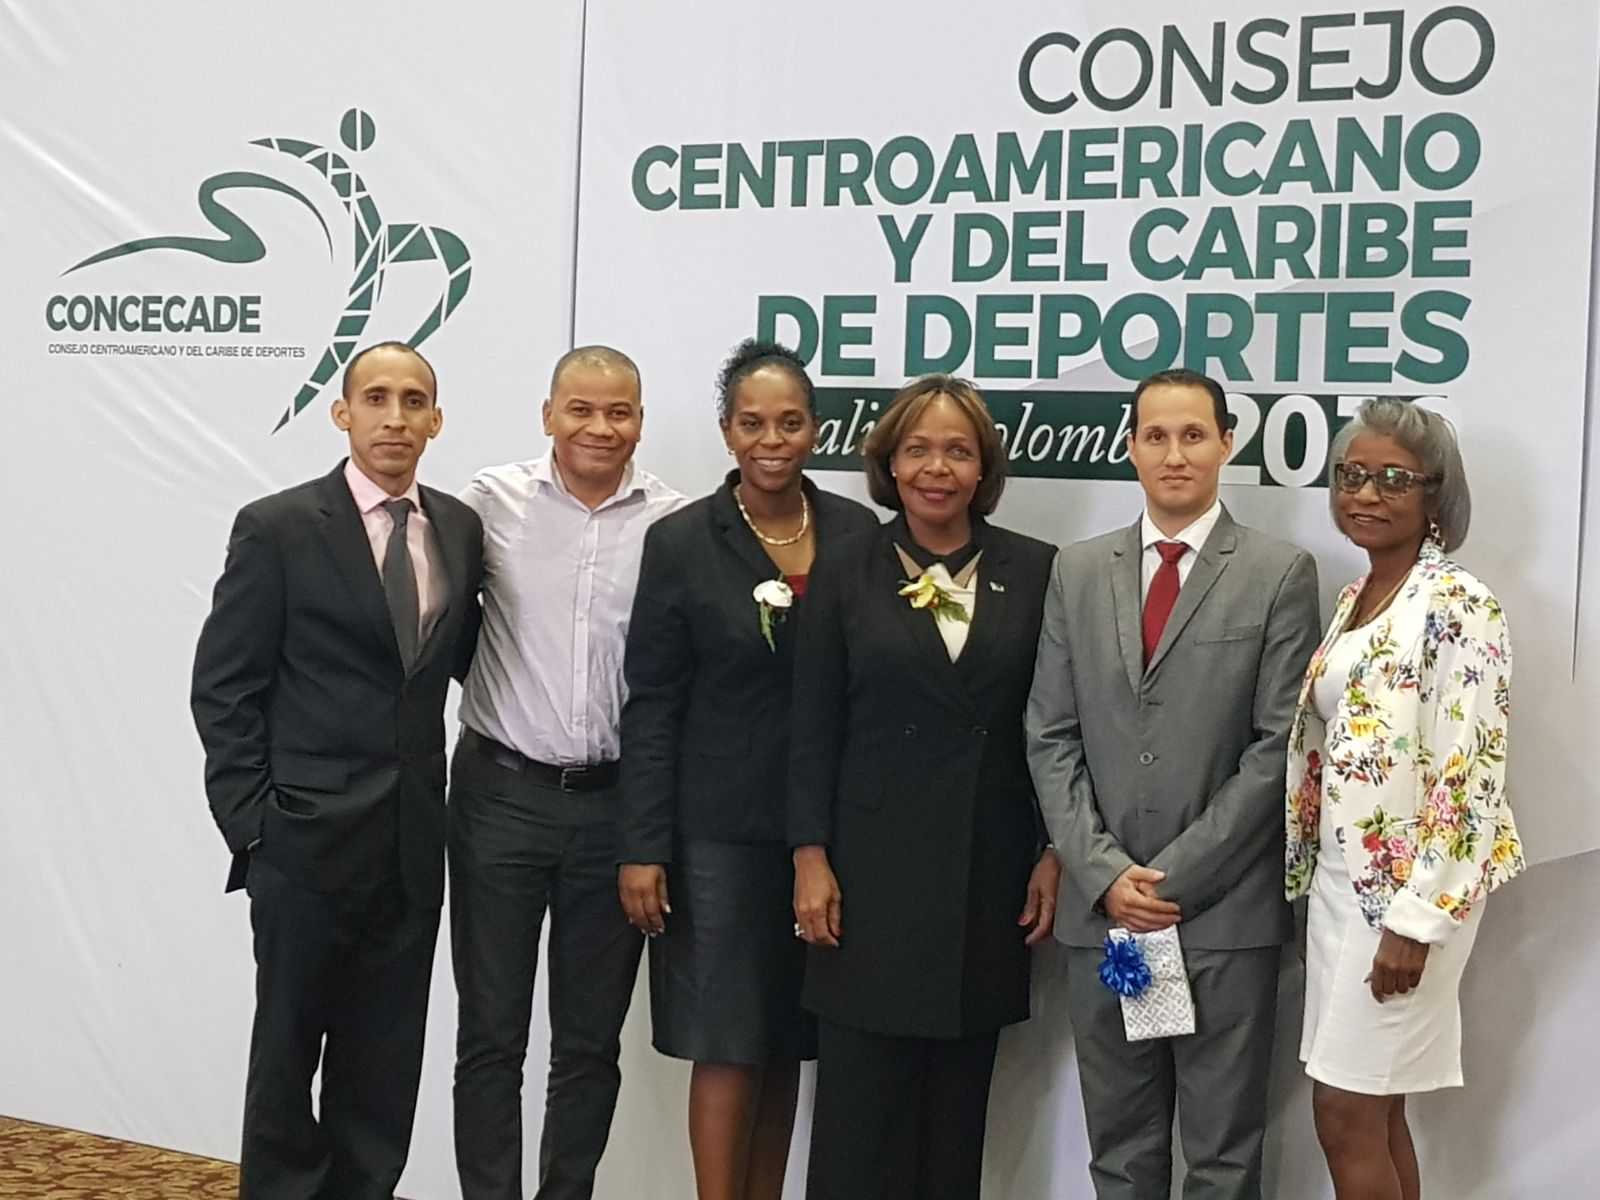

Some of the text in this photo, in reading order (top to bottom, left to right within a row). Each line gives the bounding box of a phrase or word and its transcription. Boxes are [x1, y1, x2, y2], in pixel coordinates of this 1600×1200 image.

[1018, 6, 1495, 114] CONSEJO
[632, 113, 1481, 211] CENTROAMERICANO
[878, 200, 1472, 282] Y DEL CARIBE
[46, 295, 261, 333] CONCECADE
[48, 343, 305, 358] CONSEJO CENTROAMERICANO Y DEL CARIBE DE DEPORTES
[757, 290, 1471, 384] DE DEPORTES
[811, 399, 880, 456] ali
